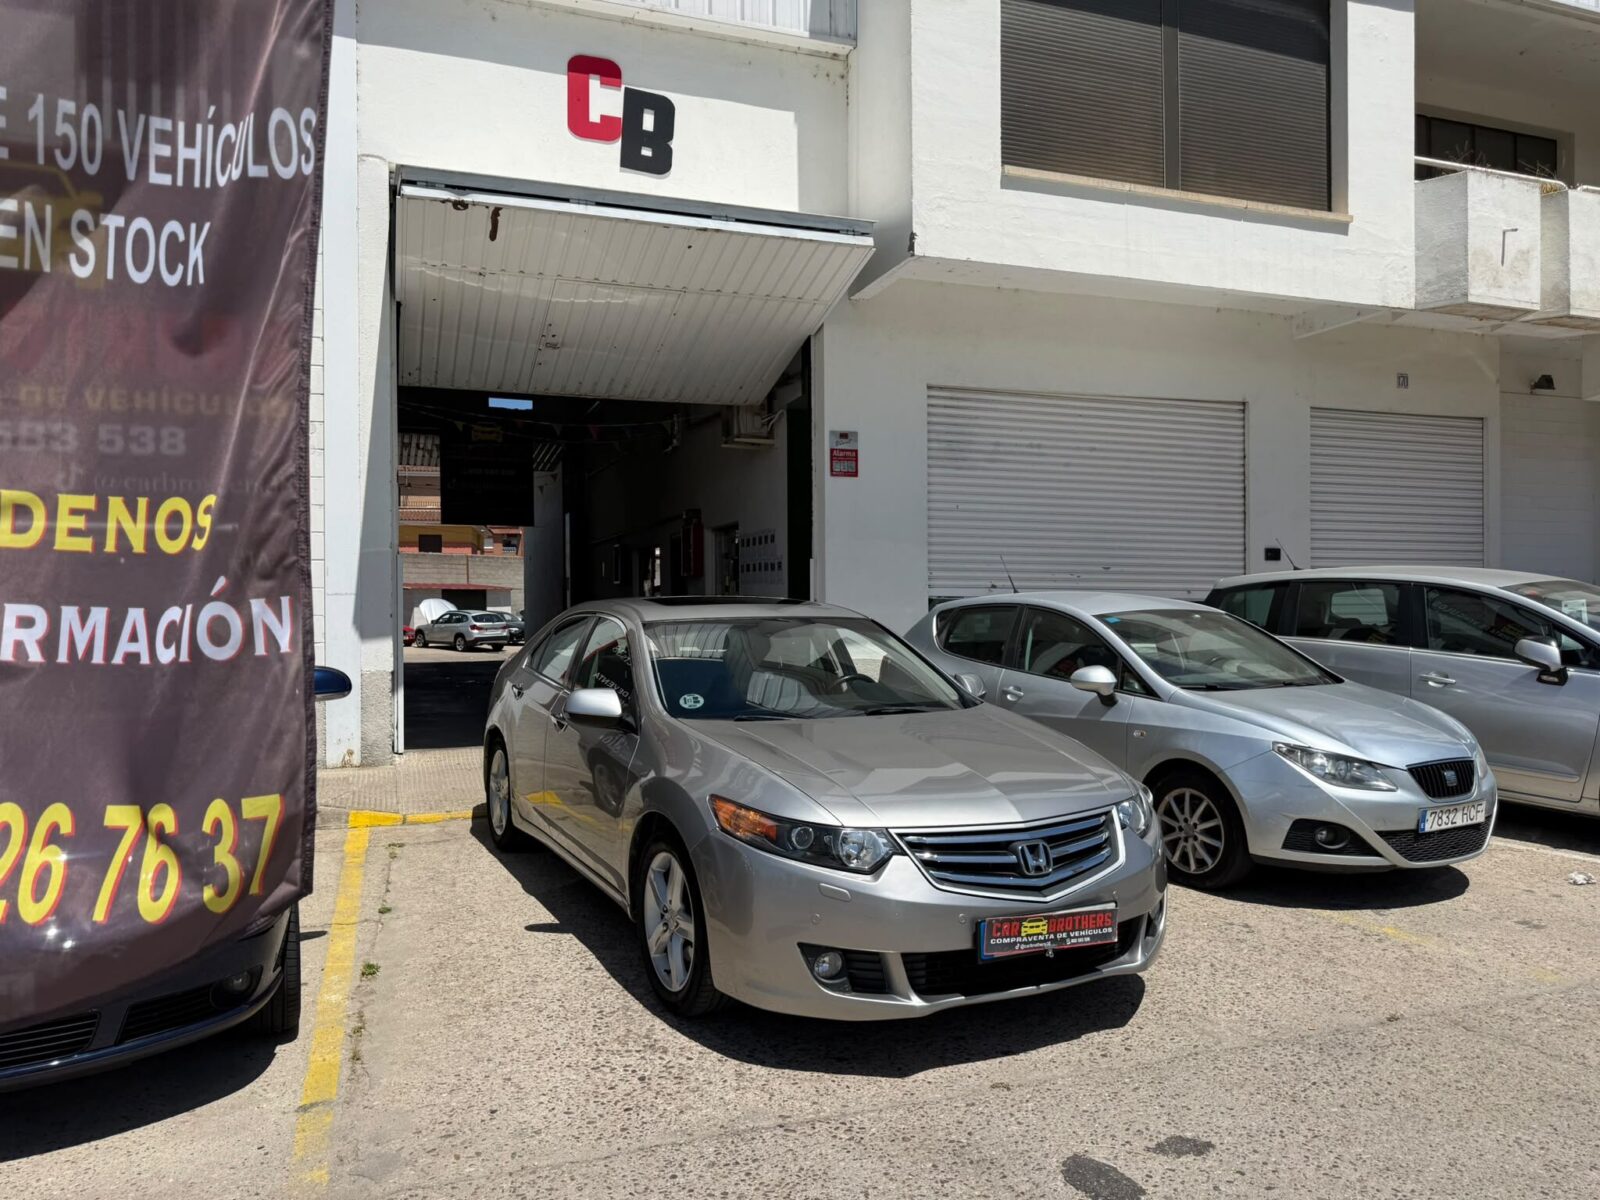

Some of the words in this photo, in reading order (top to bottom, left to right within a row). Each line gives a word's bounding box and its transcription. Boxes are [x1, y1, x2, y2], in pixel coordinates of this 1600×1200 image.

[28, 93, 103, 176] 150
[117, 105, 317, 189] VEHÍCULOS
[567, 54, 676, 176] CB
[0, 199, 51, 273] EN
[69, 208, 211, 287] STOCK
[0, 489, 218, 555] DENOS
[0, 575, 294, 665] RMACIÓN
[92, 803, 182, 925] 76
[202, 794, 285, 914] 37
[1429, 808, 1458, 830] 7832
[1462, 803, 1484, 824] HCF
[990, 934, 1055, 945] COMPRAVENTA
[1070, 927, 1113, 937] VEHÍCULOS
[992, 921, 1020, 938] CAR
[1048, 912, 1113, 933] BROTHERS
